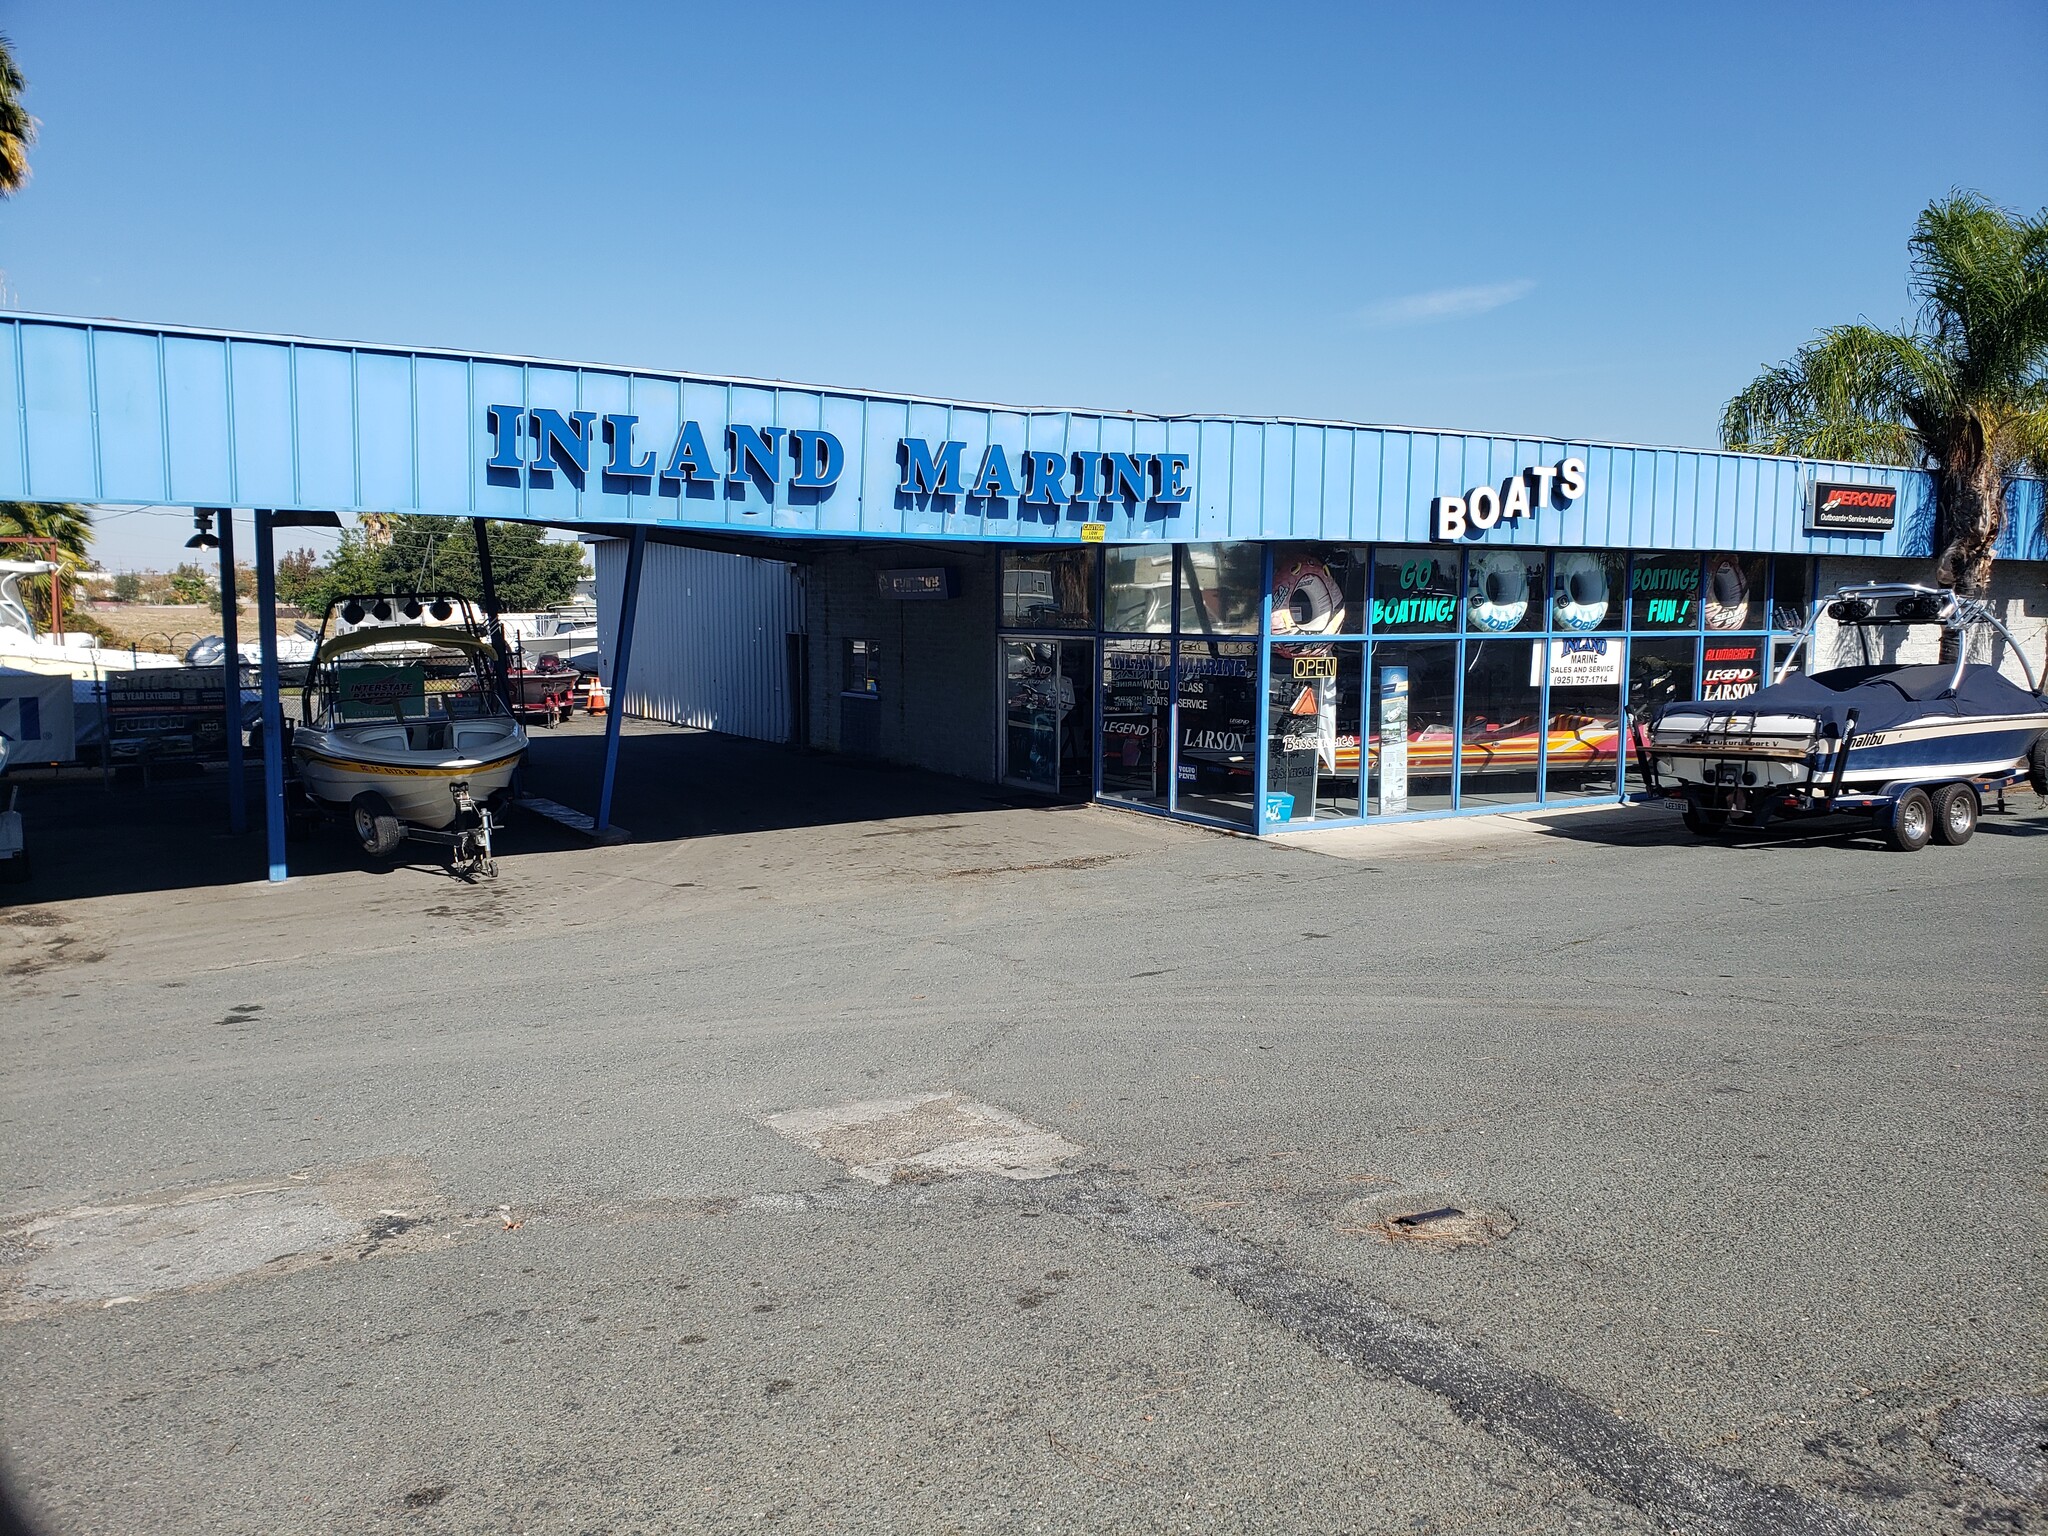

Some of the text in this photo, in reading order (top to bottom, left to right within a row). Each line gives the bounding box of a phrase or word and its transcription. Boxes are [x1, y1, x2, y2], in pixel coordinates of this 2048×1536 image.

[487, 404, 1193, 505] INLAND MARINE
[1438, 457, 1585, 540] BOATS
[1827, 490, 1895, 508] MERCURY
[1400, 558, 1432, 589] GO
[1632, 568, 1698, 591] BOATINGS
[1372, 596, 1457, 625] BOATING!
[1561, 638, 1607, 657] INLAND
[1705, 648, 1756, 661] ALUMACRAFT
[1111, 653, 1247, 676] INLAND MARINE
[1571, 654, 1598, 664] MARINE
[1295, 660, 1335, 676] OPEN
[1589, 665, 1614, 673] SERVICE
[1706, 669, 1754, 681] LEGEND
[351, 682, 413, 692] INTERSTATE
[1142, 680, 1203, 693] WORLD CLASS
[1554, 676, 1608, 685] (925) 757-1714
[111, 692, 126, 700] ONE
[126, 692, 143, 700] YEAR
[145, 691, 180, 700] EXTENDED
[1703, 683, 1758, 700] LARSON
[1146, 696, 1169, 706] BOATS
[1178, 698, 1208, 709] SERVICE
[1103, 721, 1149, 736] LEGEND
[1184, 728, 1246, 751] LARSON
[1178, 765, 1195, 773] VOLVO
[1178, 772, 1196, 780] PENTA
